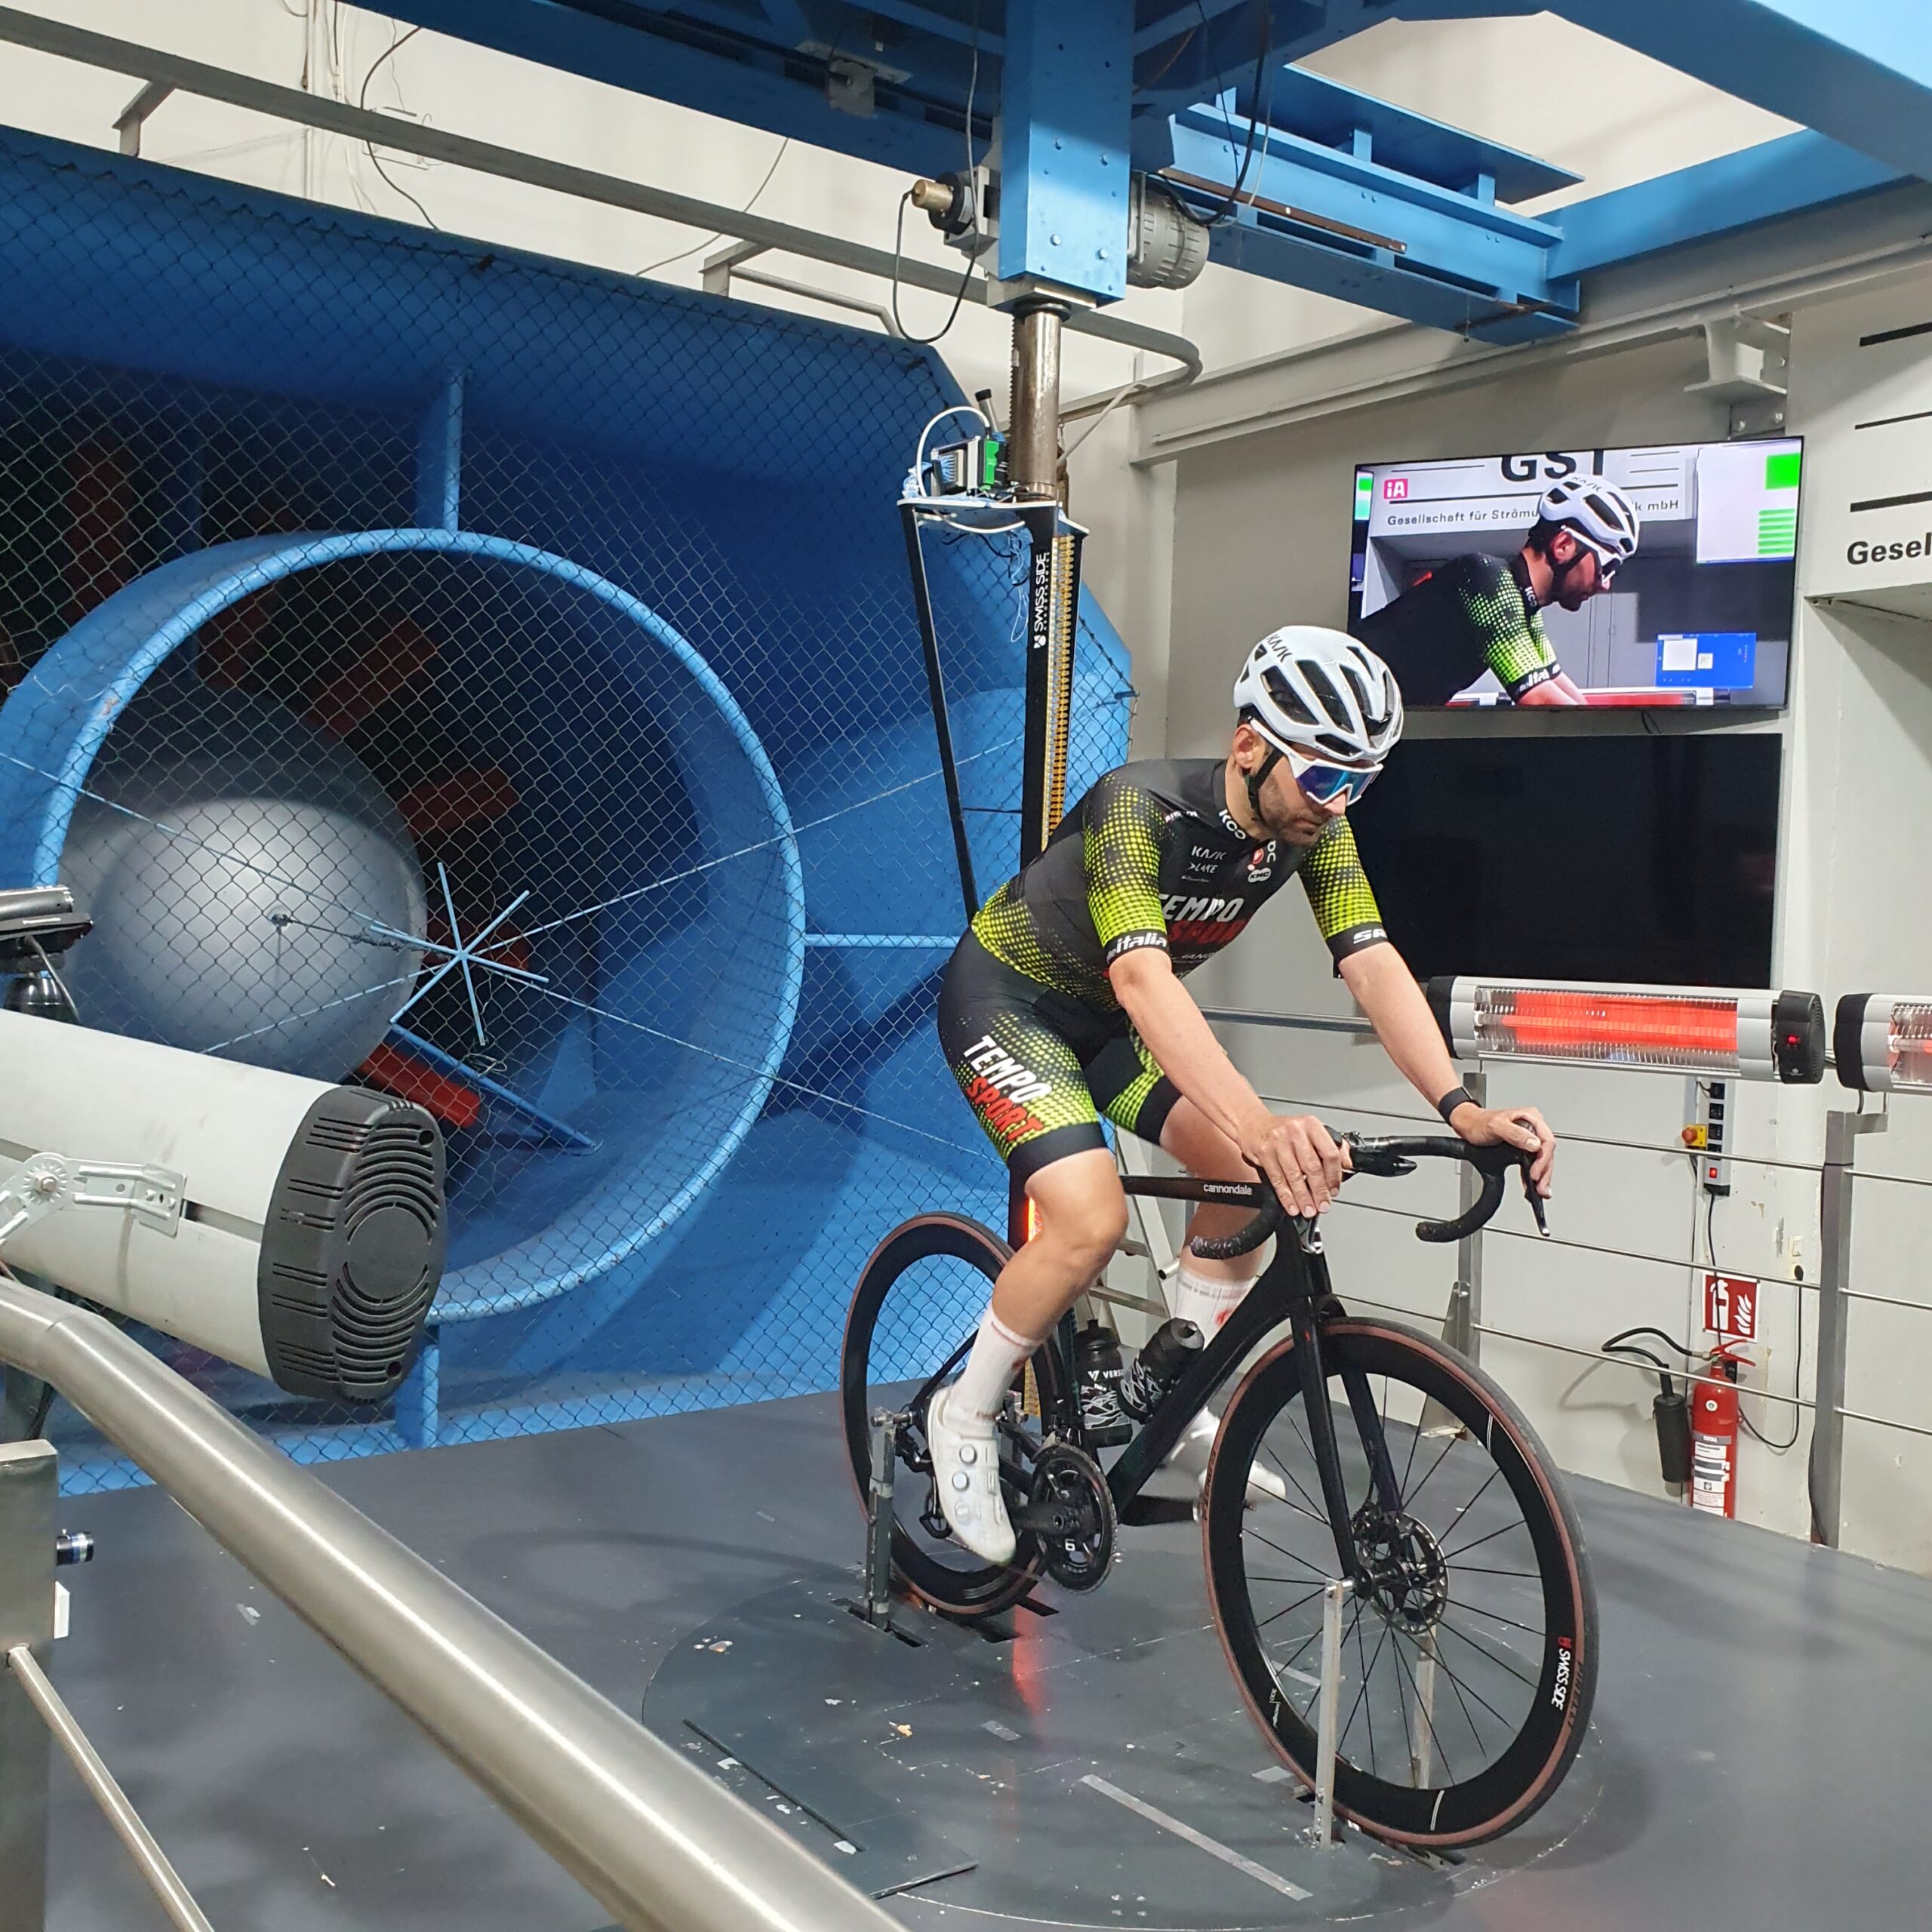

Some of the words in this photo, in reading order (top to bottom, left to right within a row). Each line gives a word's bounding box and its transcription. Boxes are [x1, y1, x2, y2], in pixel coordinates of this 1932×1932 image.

[1387, 512, 1464, 525] Gesellschaft
[1469, 510, 1487, 521] für
[1647, 500, 1678, 511] mbH
[1035, 553, 1047, 586] SIDE
[1034, 586, 1045, 632] SWISS
[963, 1034, 1053, 1104] TEMPO
[967, 1077, 1044, 1142] SPORT
[1203, 1183, 1253, 1195] cannondale
[1557, 1647, 1571, 1685] SWISS
[1551, 1683, 1567, 1711] SIDE
